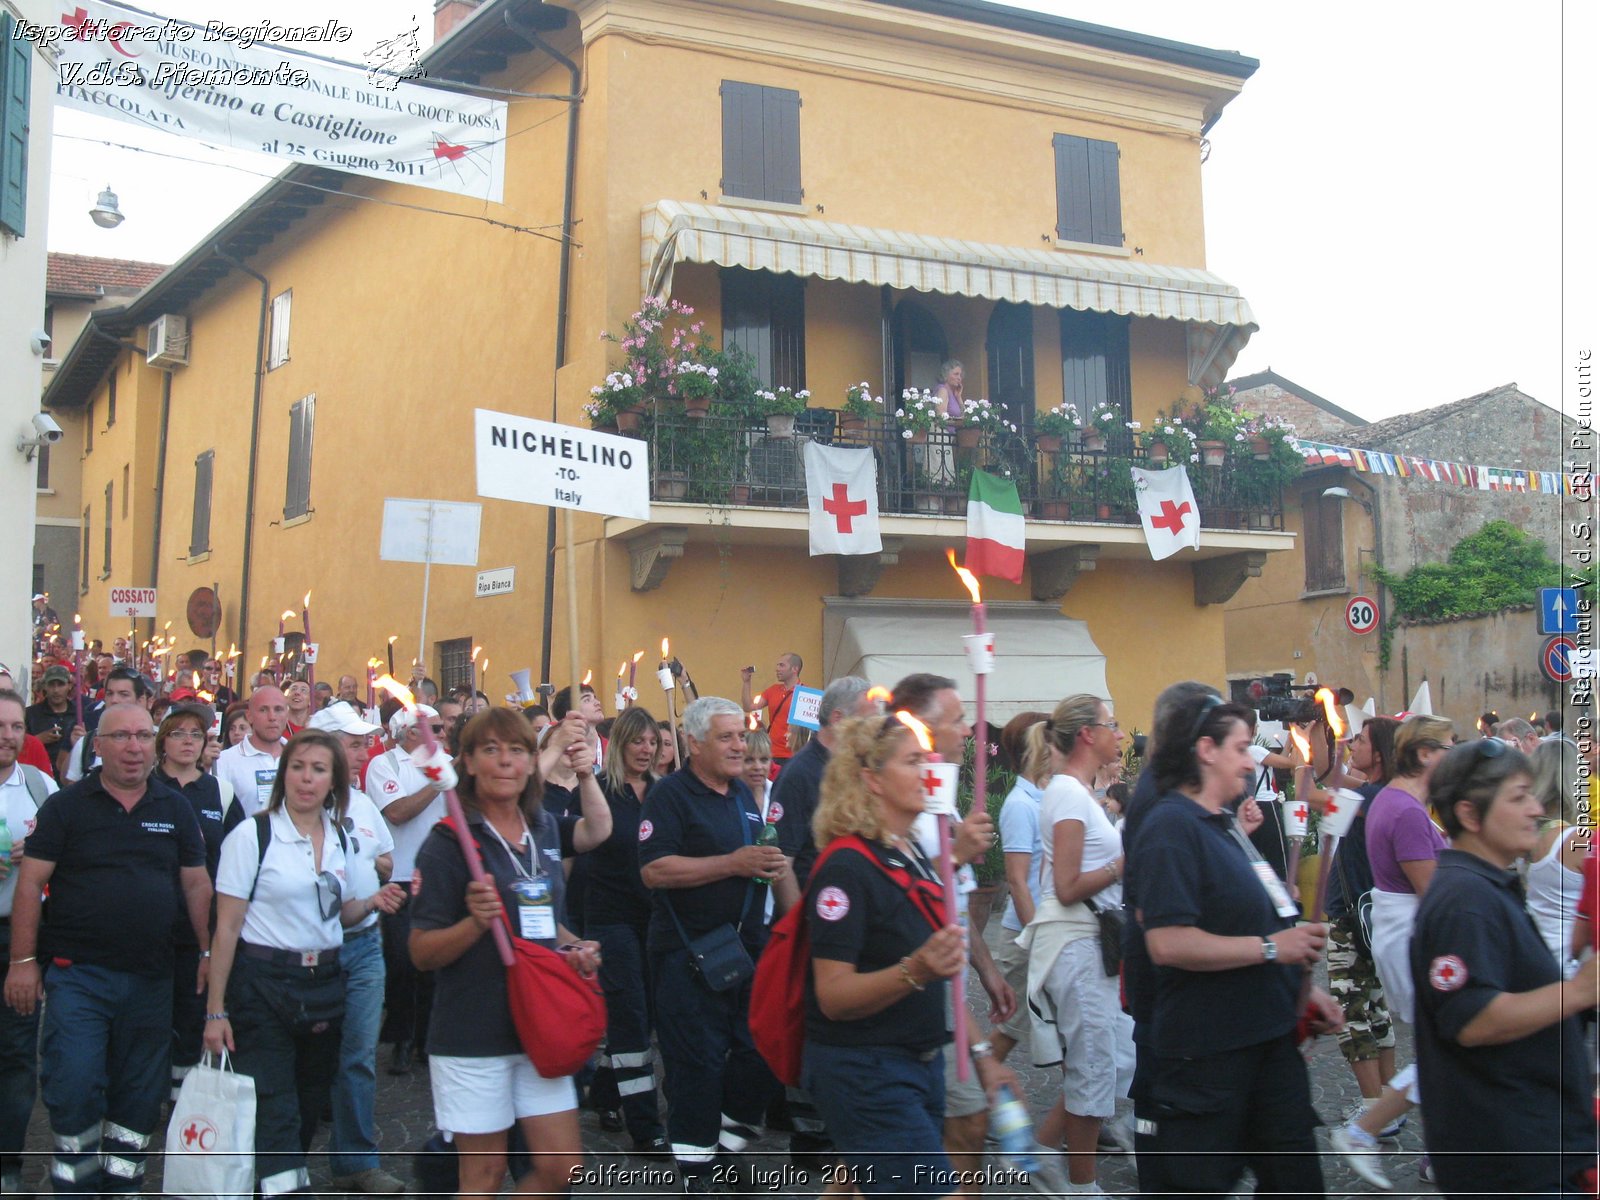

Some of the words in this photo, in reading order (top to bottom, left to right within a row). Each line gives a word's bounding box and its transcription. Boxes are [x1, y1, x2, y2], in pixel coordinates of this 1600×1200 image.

[155, 40, 212, 66] MUSEO
[215, 56, 350, 101] INTEONALE
[356, 90, 403, 112] DELLA
[408, 102, 454, 123] CROCE
[458, 113, 501, 131] ROSSA
[56, 81, 186, 129] FIACCOLATA
[250, 101, 266, 117] a
[274, 102, 397, 146] Castiglione
[262, 139, 279, 154] al
[285, 142, 306, 157] 25
[313, 148, 380, 171] Giugno
[386, 158, 426, 176] 2011
[491, 425, 633, 470] NICHELINO
[555, 488, 582, 506] Italy
[112, 589, 155, 604] COSSATO
[478, 582, 491, 593] Ripa
[491, 580, 512, 590] Bianca
[1351, 606, 1372, 624] 30
